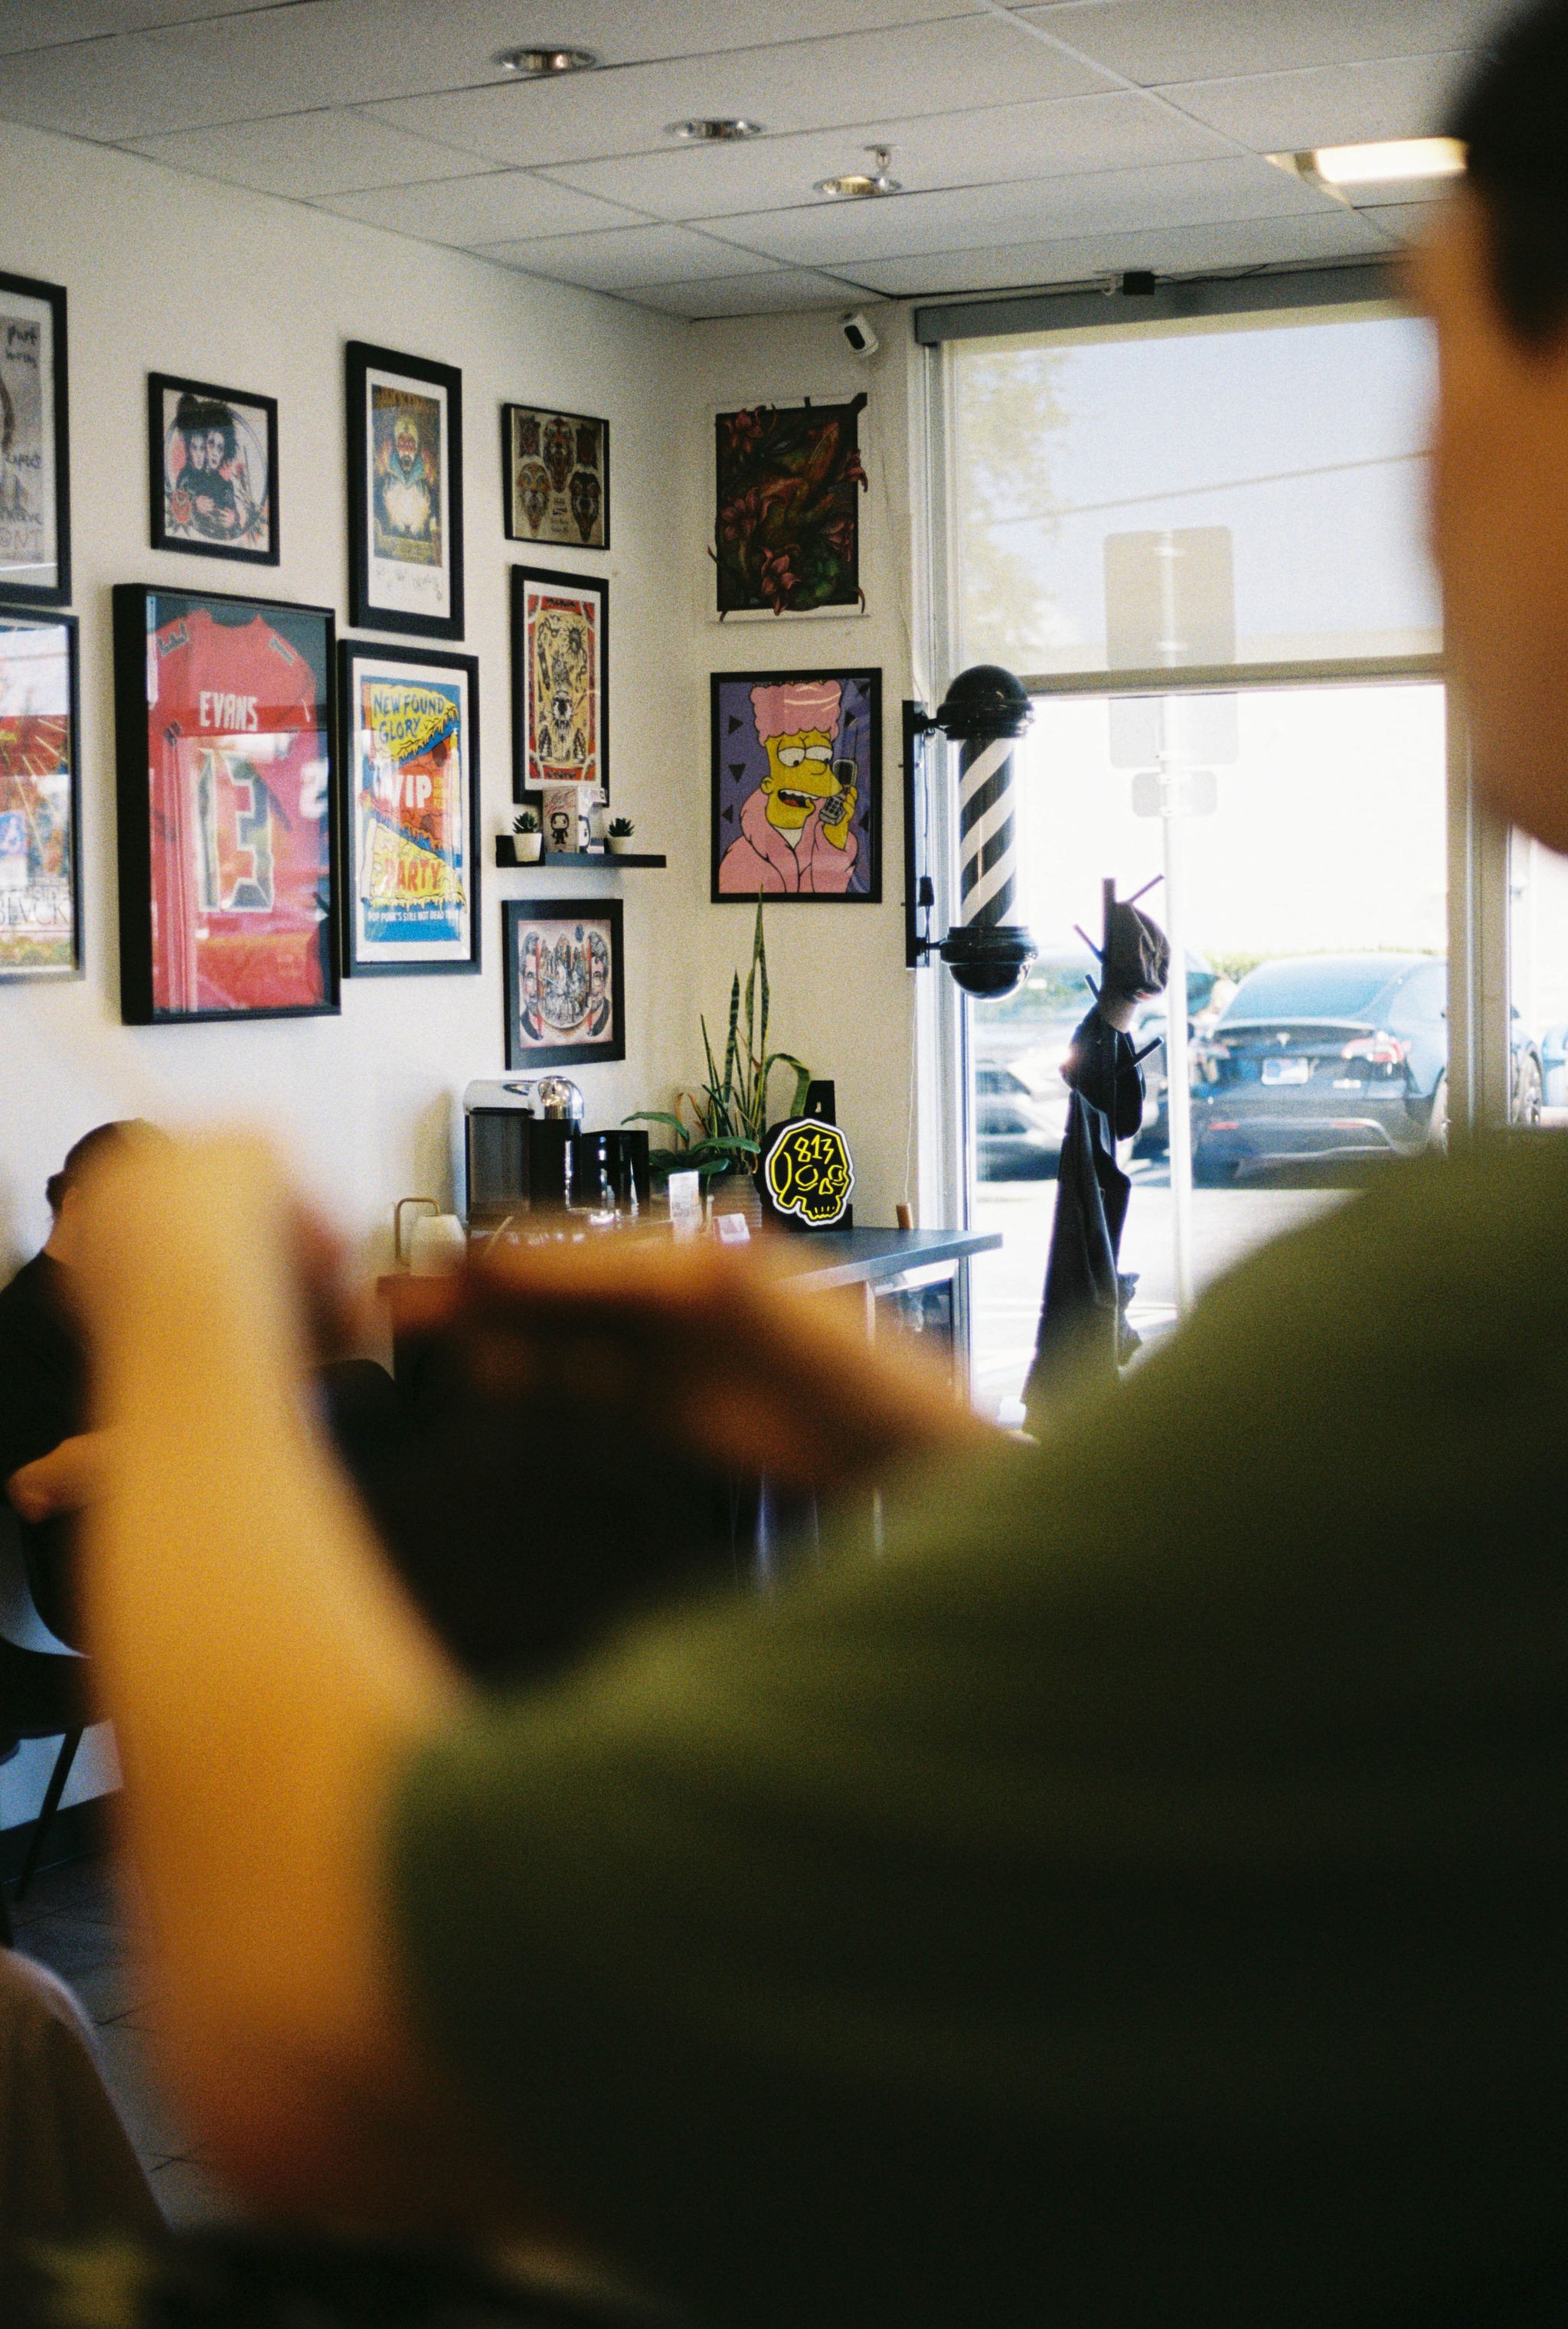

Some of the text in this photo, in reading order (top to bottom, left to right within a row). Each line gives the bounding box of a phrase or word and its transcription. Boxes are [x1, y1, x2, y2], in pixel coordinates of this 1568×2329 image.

[199, 691, 259, 732] EVANS
[374, 693, 446, 717] NEW FOUND
[379, 717, 421, 744] GLORY
[390, 774, 433, 808] VIP
[197, 747, 275, 913] 13
[384, 857, 442, 892] PARTY
[794, 1133, 835, 1164] 813
